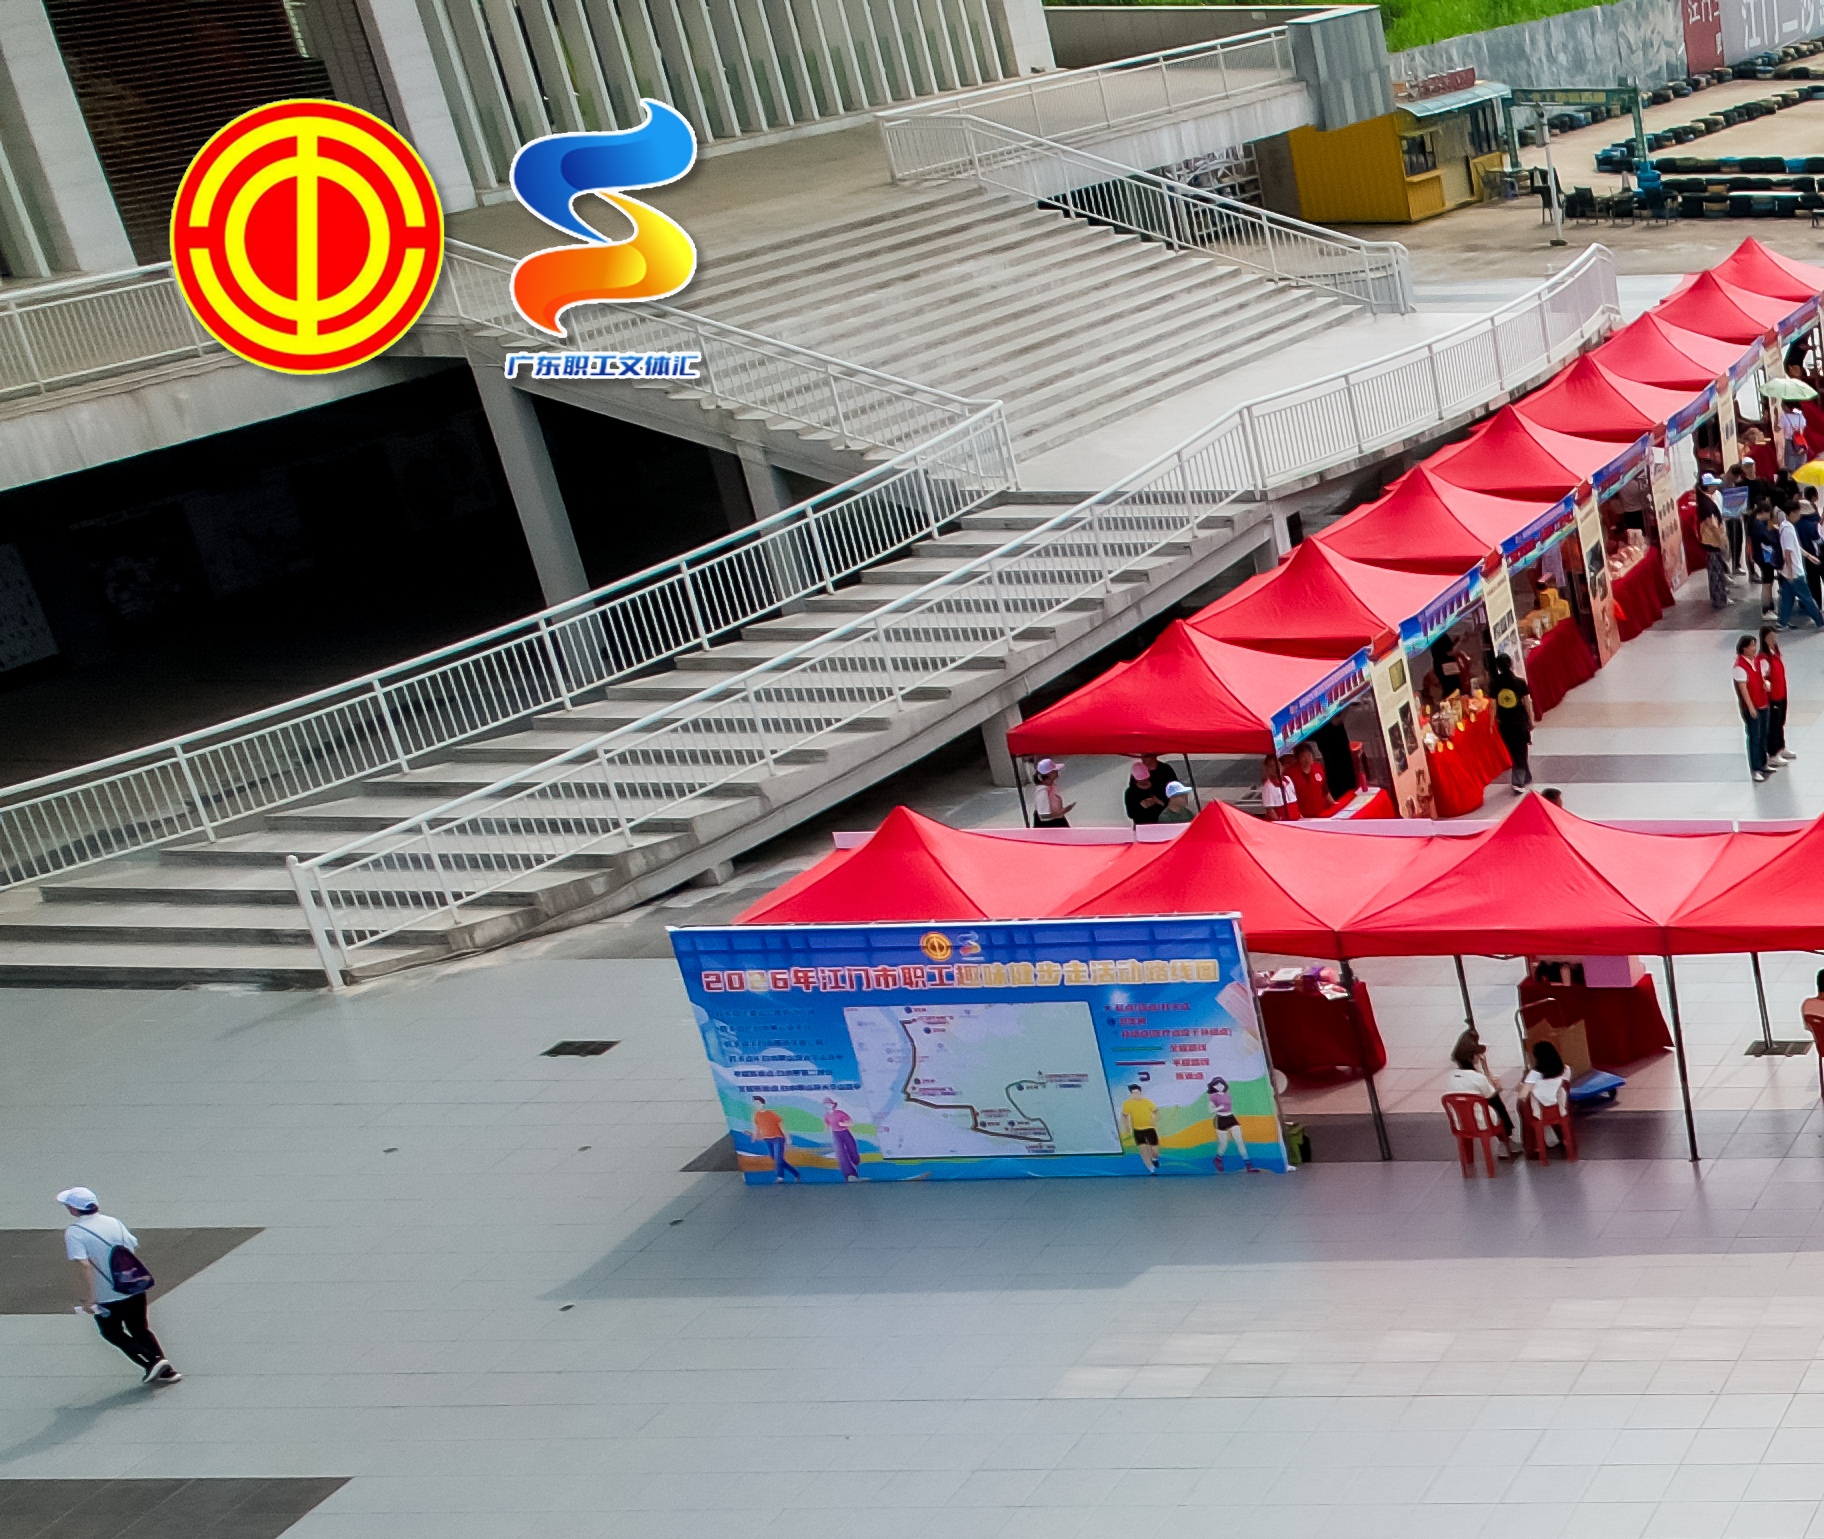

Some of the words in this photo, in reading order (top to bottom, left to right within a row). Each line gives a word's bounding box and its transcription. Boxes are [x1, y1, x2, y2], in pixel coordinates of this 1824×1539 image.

[702, 959, 1220, 993] 2026年江门市职工趣味健步走活动路线图
